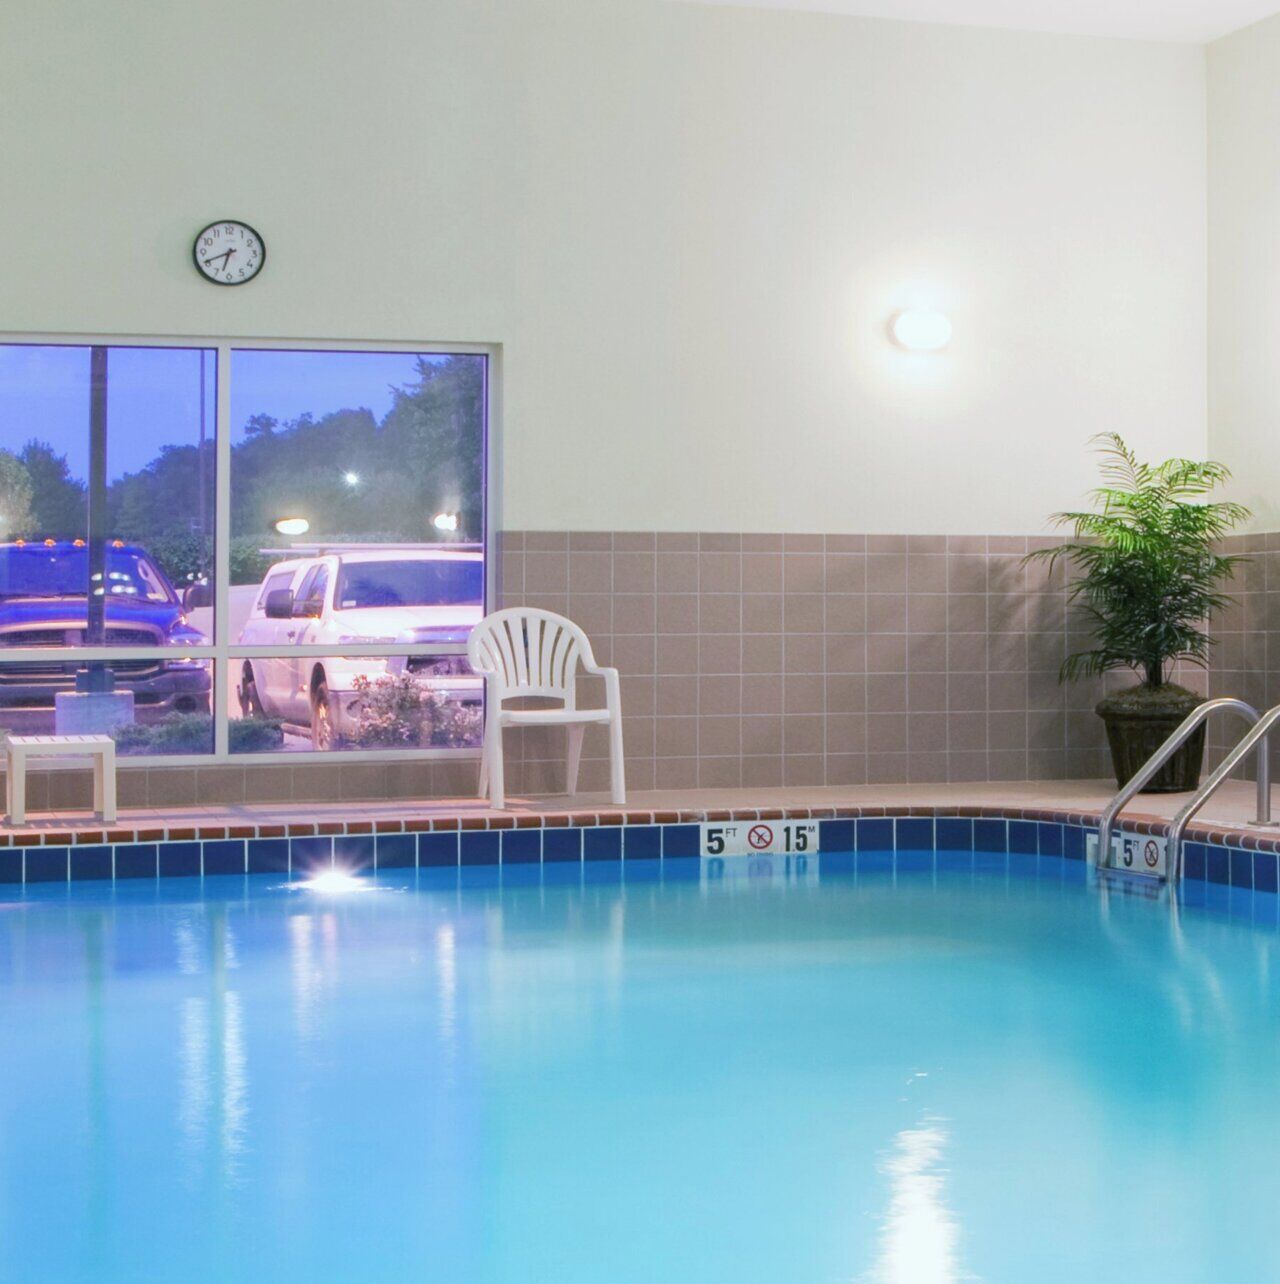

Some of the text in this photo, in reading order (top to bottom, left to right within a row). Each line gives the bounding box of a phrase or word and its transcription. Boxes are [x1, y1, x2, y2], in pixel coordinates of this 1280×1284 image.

[225, 227, 233, 235] 12
[204, 238, 213, 246] 10
[247, 239, 253, 247] 2
[200, 248, 206, 256] 9
[247, 260, 253, 268] 4
[226, 272, 232, 280] 6
[707, 828, 737, 854] 5 FT
[1124, 839, 1133, 866] 5
